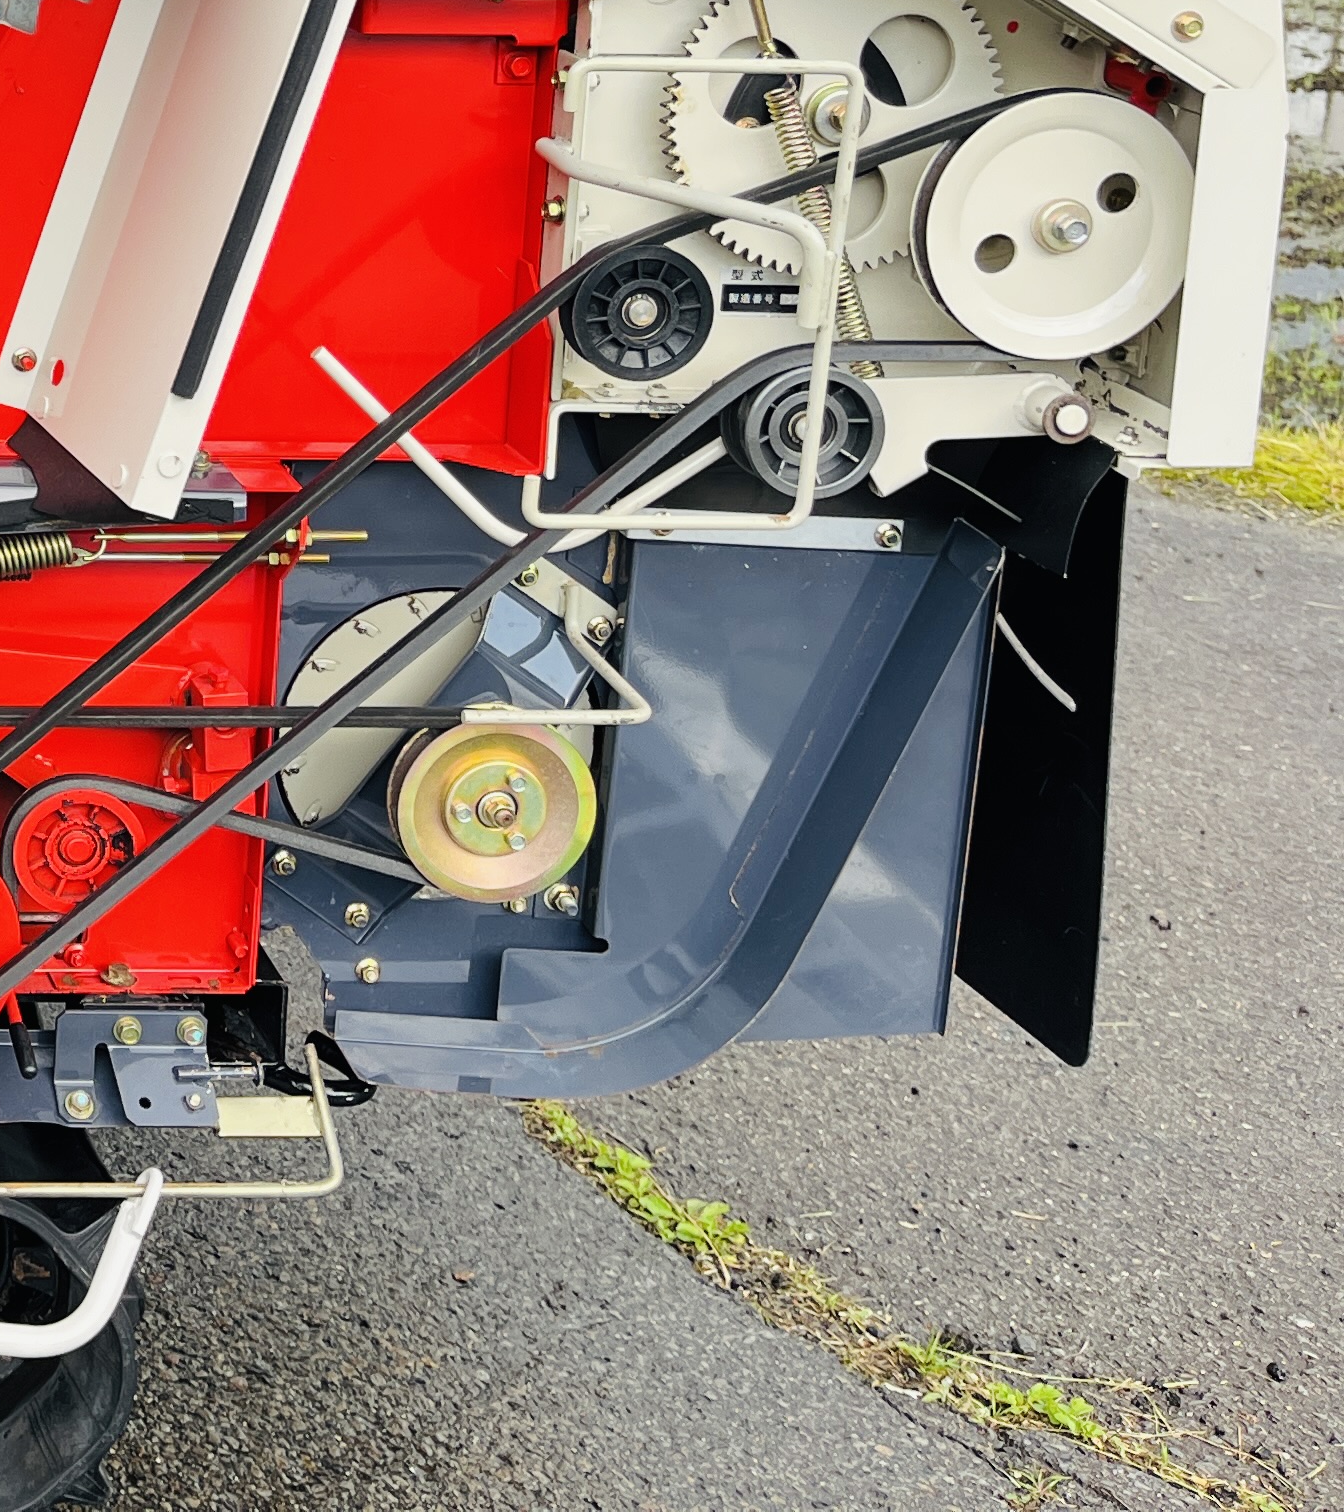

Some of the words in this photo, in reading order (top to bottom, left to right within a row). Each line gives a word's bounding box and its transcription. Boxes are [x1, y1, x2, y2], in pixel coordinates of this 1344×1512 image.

[731, 269, 764, 281] 型式
[728, 292, 774, 305] 製造番号
